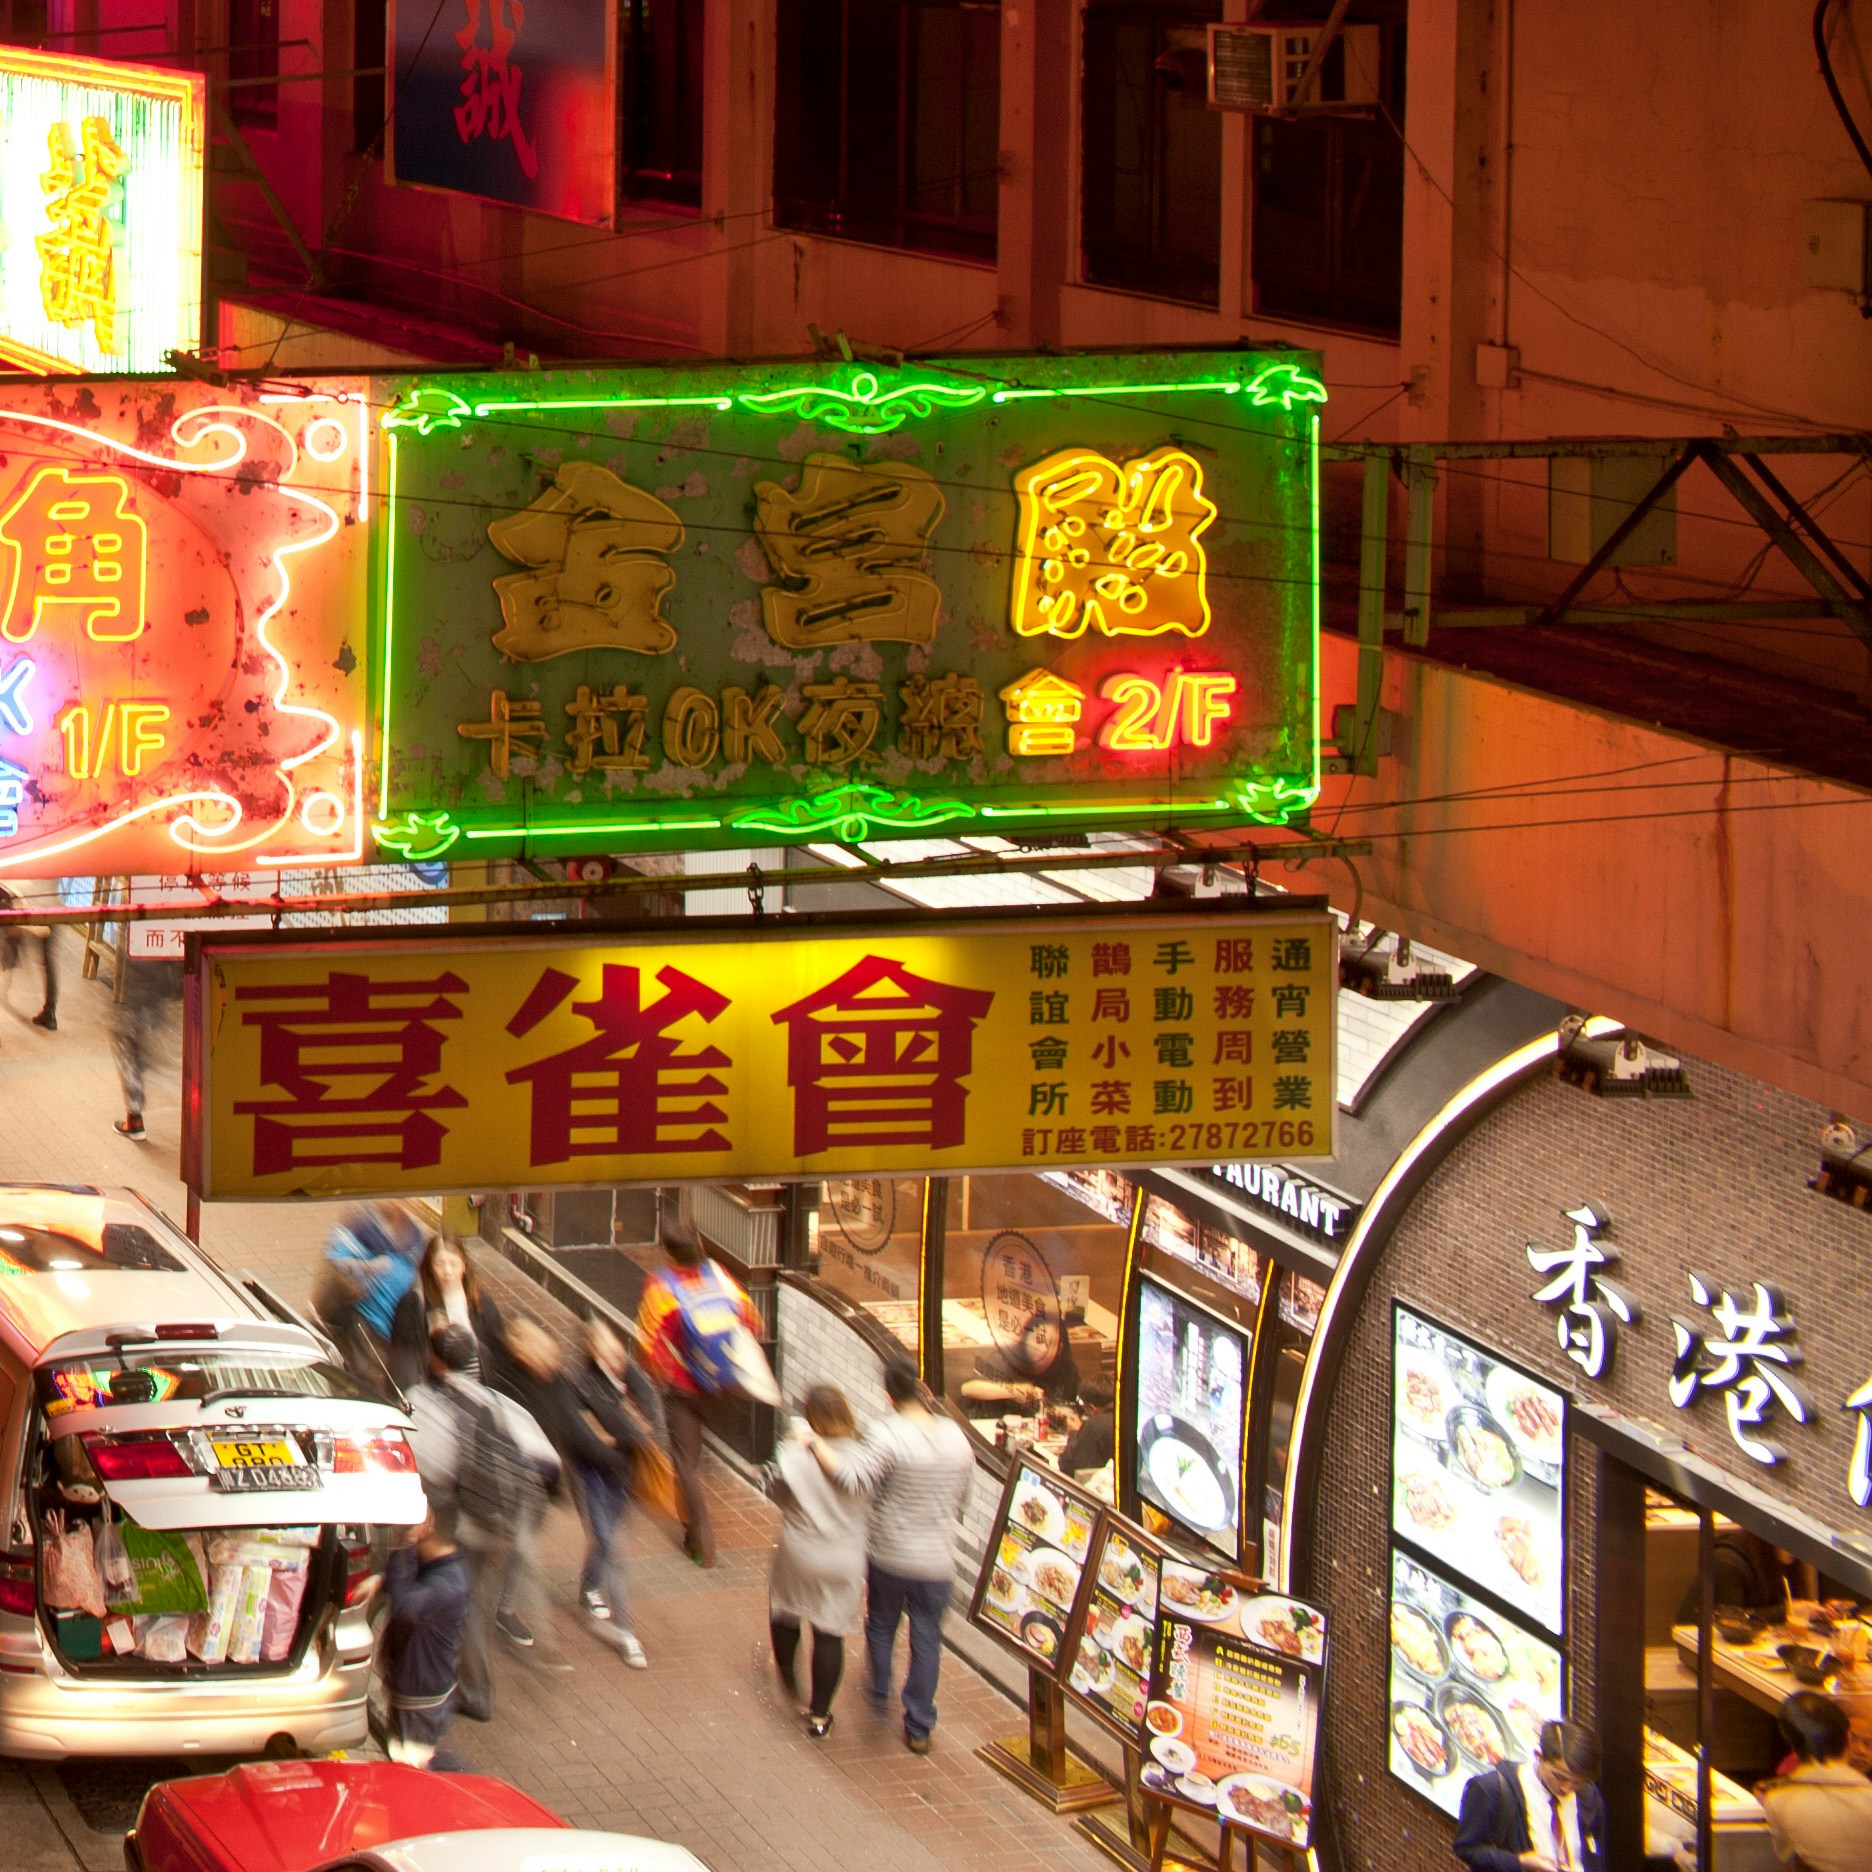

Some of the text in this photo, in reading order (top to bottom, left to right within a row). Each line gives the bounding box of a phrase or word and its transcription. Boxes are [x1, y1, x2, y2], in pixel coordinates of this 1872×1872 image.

[59, 700, 171, 781] 1/F
[1098, 669, 1238, 753] 2/F
[232, 952, 999, 1179] 喜雀會
[1027, 942, 1073, 1118] 聯誼會所
[1089, 941, 1133, 1117] 鵲局小菜
[1151, 939, 1197, 1116] 手動電動
[1211, 937, 1256, 1114] 服務周到
[1268, 936, 1315, 1112] 通宵營業
[234, 1442, 267, 1458] GT
